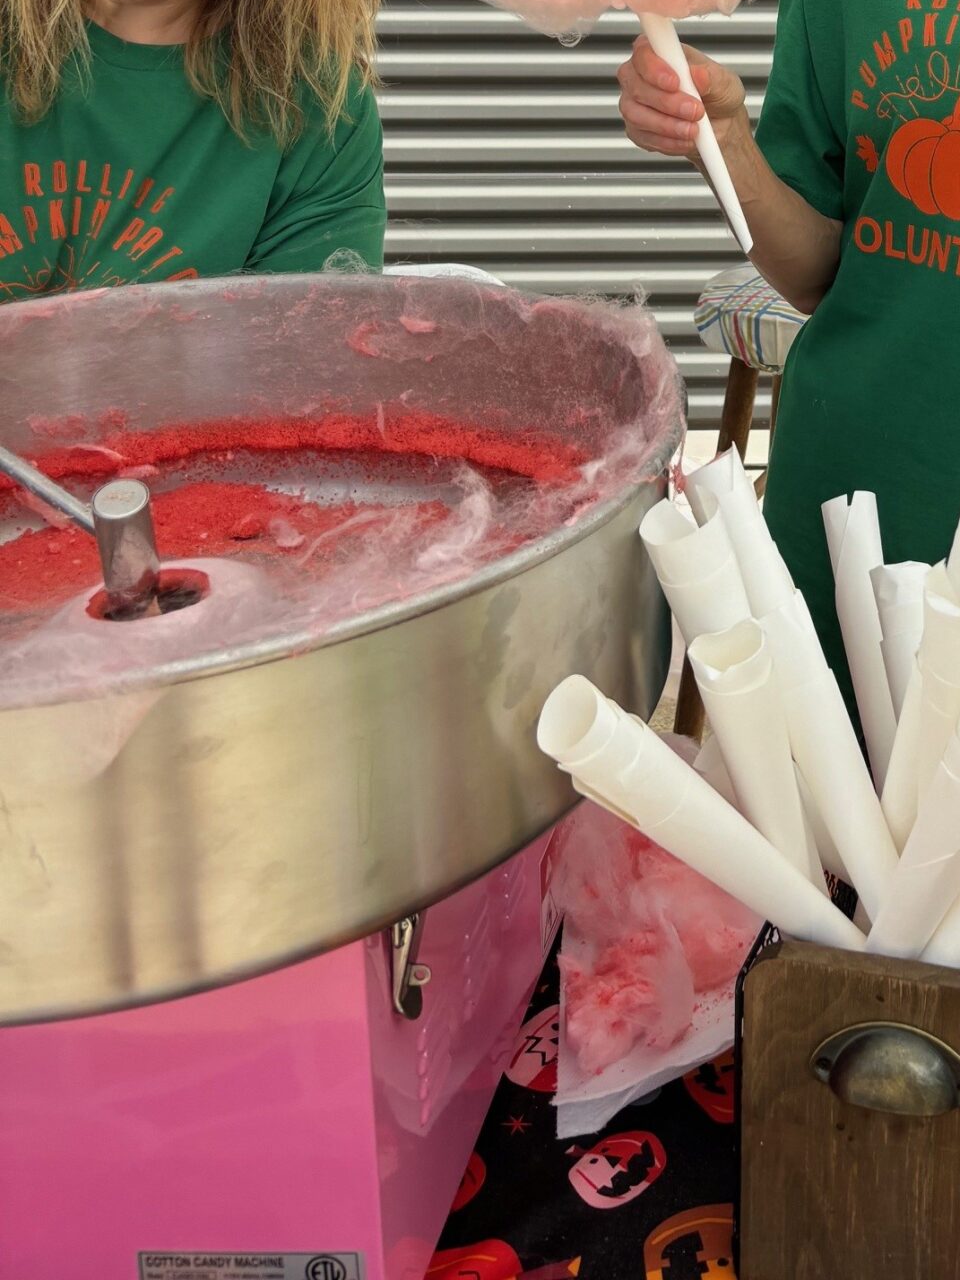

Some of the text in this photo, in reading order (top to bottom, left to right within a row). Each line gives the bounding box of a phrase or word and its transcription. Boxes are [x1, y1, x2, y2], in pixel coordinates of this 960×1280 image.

[0, 196, 199, 283] MPKIN PAT
[145, 1256, 284, 1268] COTTON CANDY MACHINE
